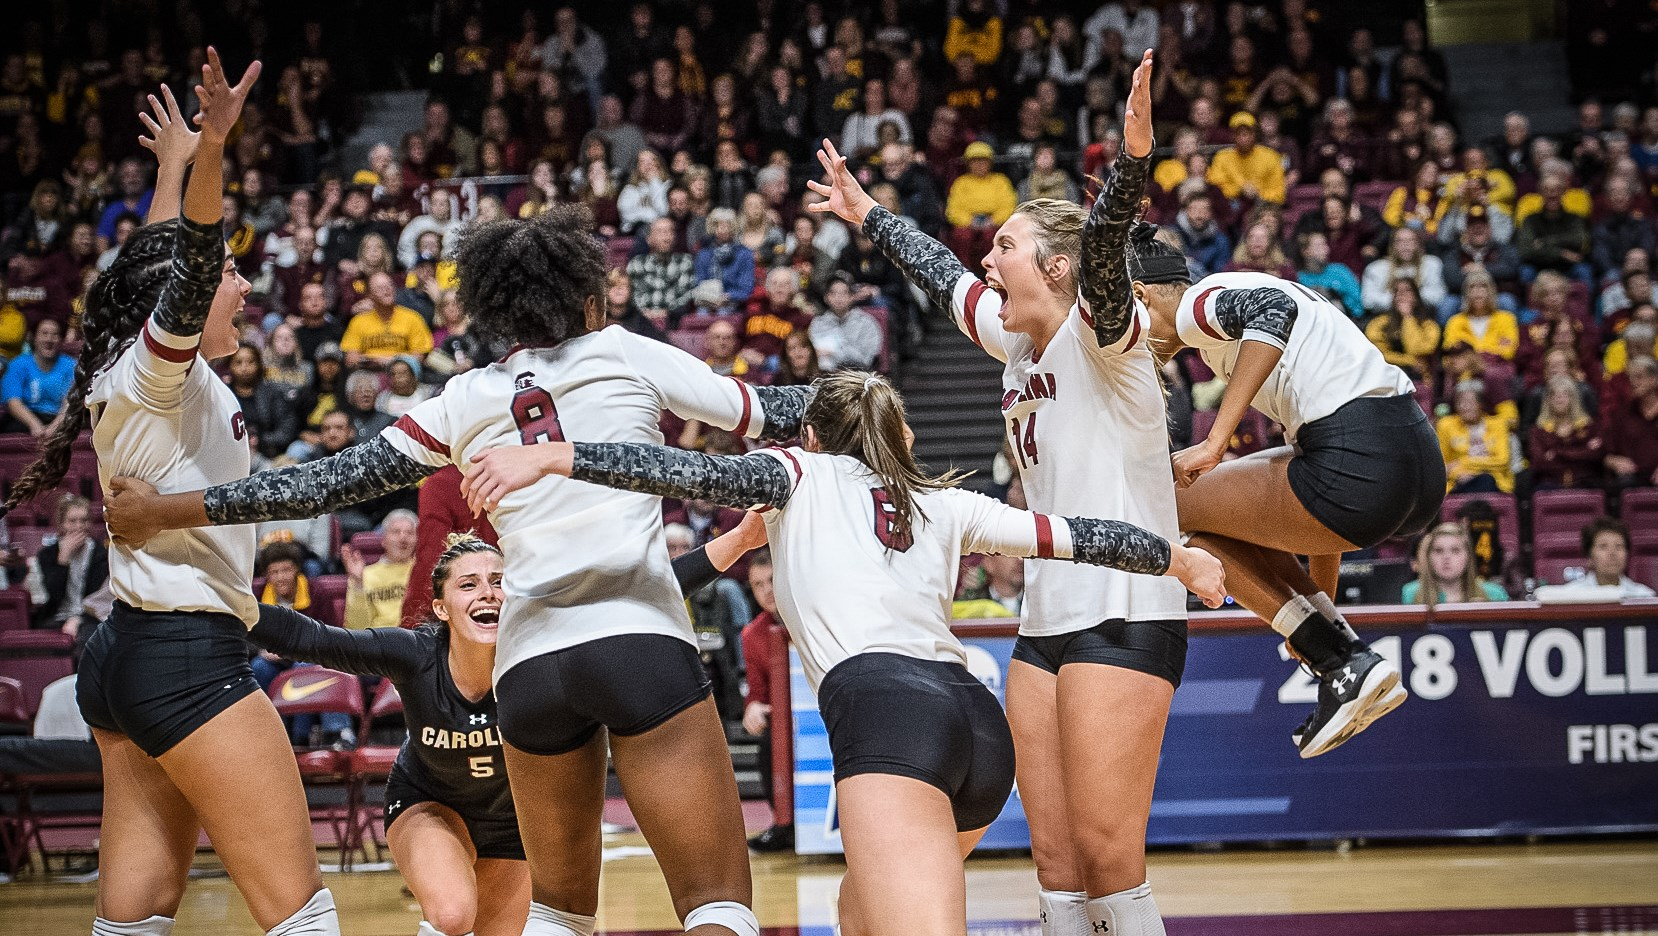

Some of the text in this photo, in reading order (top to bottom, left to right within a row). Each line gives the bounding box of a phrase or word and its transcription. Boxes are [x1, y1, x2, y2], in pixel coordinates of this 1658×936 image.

[510, 386, 566, 445] 8
[1011, 412, 1039, 469] 14
[1470, 626, 1658, 698] VOLL
[468, 755, 495, 778] 5
[1567, 723, 1658, 764] FIRS
